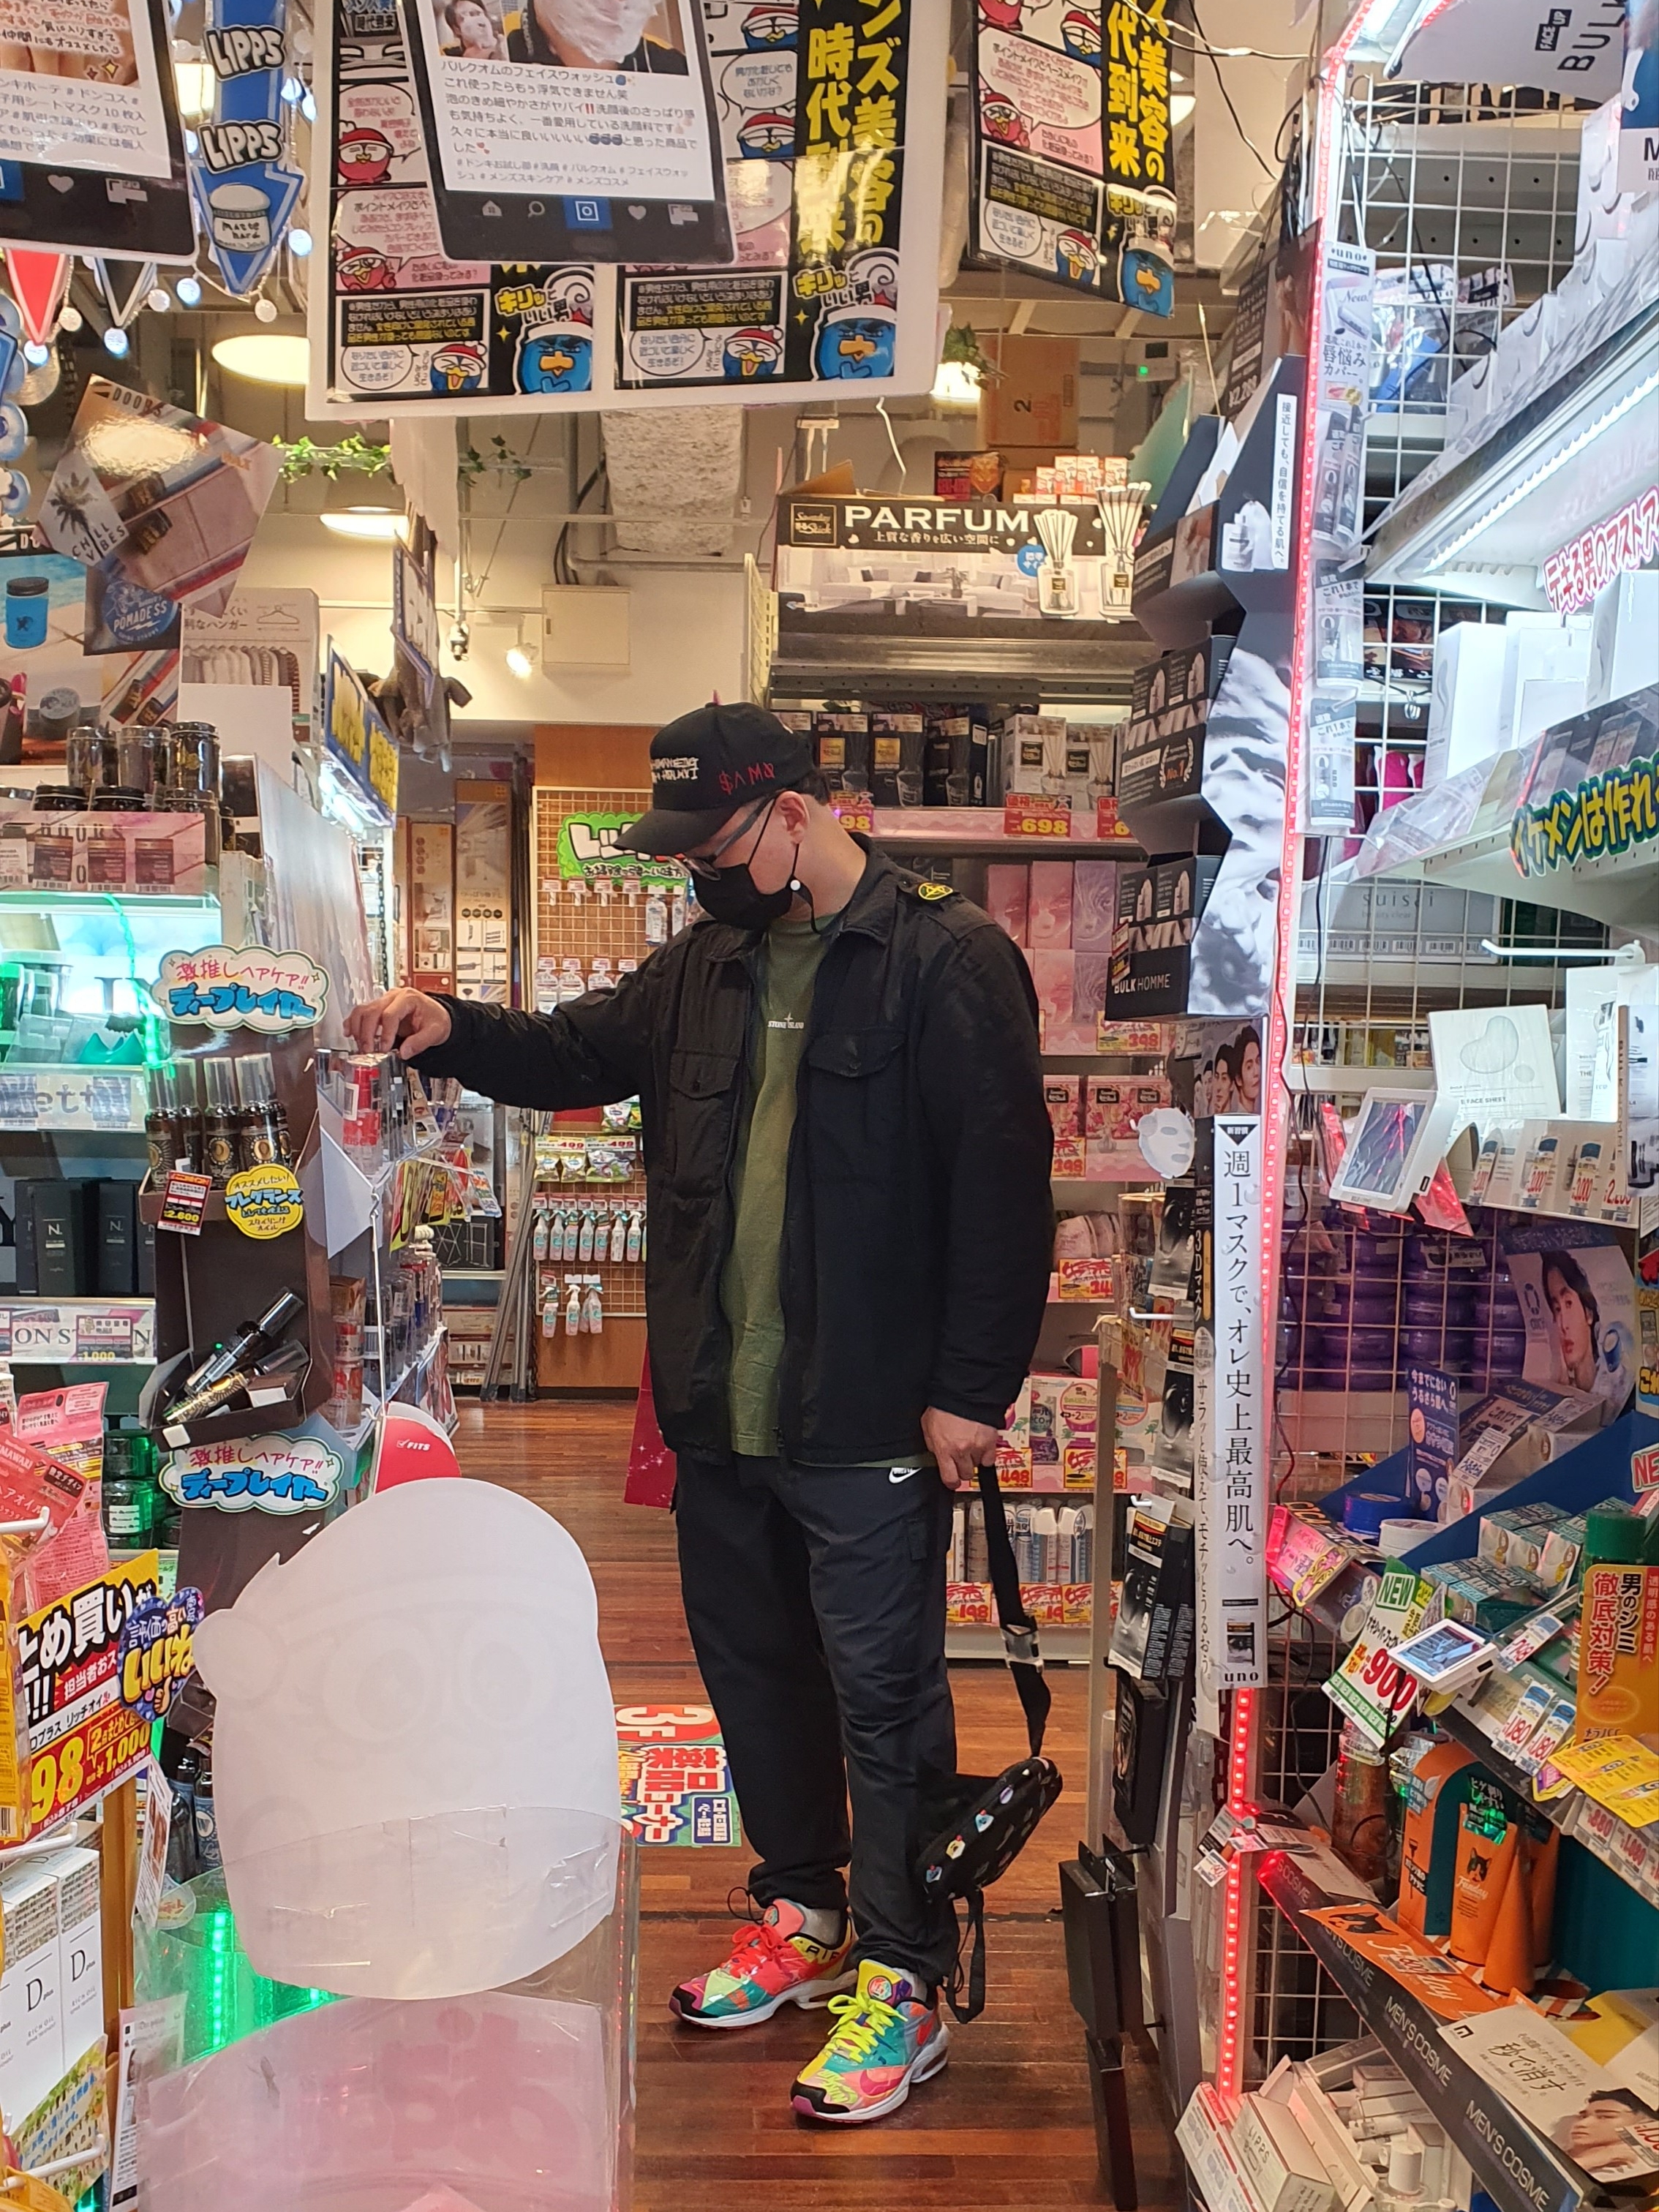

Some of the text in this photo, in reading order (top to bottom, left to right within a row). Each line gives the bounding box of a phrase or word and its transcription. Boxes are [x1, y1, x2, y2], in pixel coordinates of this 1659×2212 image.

[1540, 11, 1568, 50] FACE UP
[208, 28, 285, 78] LIPPS
[441, 61, 614, 86] バルクオムのフェイスウォッシュ
[444, 77, 628, 101] これ使ったらもう浮気できません笑
[202, 123, 283, 173] LIPPS
[1274, 400, 1293, 565] 接近しても、自信を持てる肌へ。
[843, 503, 1031, 535] PARFUM
[873, 530, 1000, 546] 上質な香りを広い空間に
[168, 982, 317, 1020] ディープレイヤー
[1136, 973, 1171, 992] HOMME
[224, 1188, 304, 1209] フレグランス
[1223, 1150, 1254, 1566] 週1マスクで、オレ史上最高肌へ。
[406, 1441, 431, 1452] FITS
[181, 1467, 329, 1503] ディープレイヤー
[1378, 1574, 1414, 1608] NEW
[1615, 1572, 1644, 1655] 男のシミ
[1224, 1671, 1260, 1682] uno
[1342, 1945, 1376, 1988] COSME
[1384, 1995, 1418, 2042] MEN'S
[1414, 2034, 1454, 2090] COSME
[1465, 2099, 1551, 2212] MEN'S COSME
